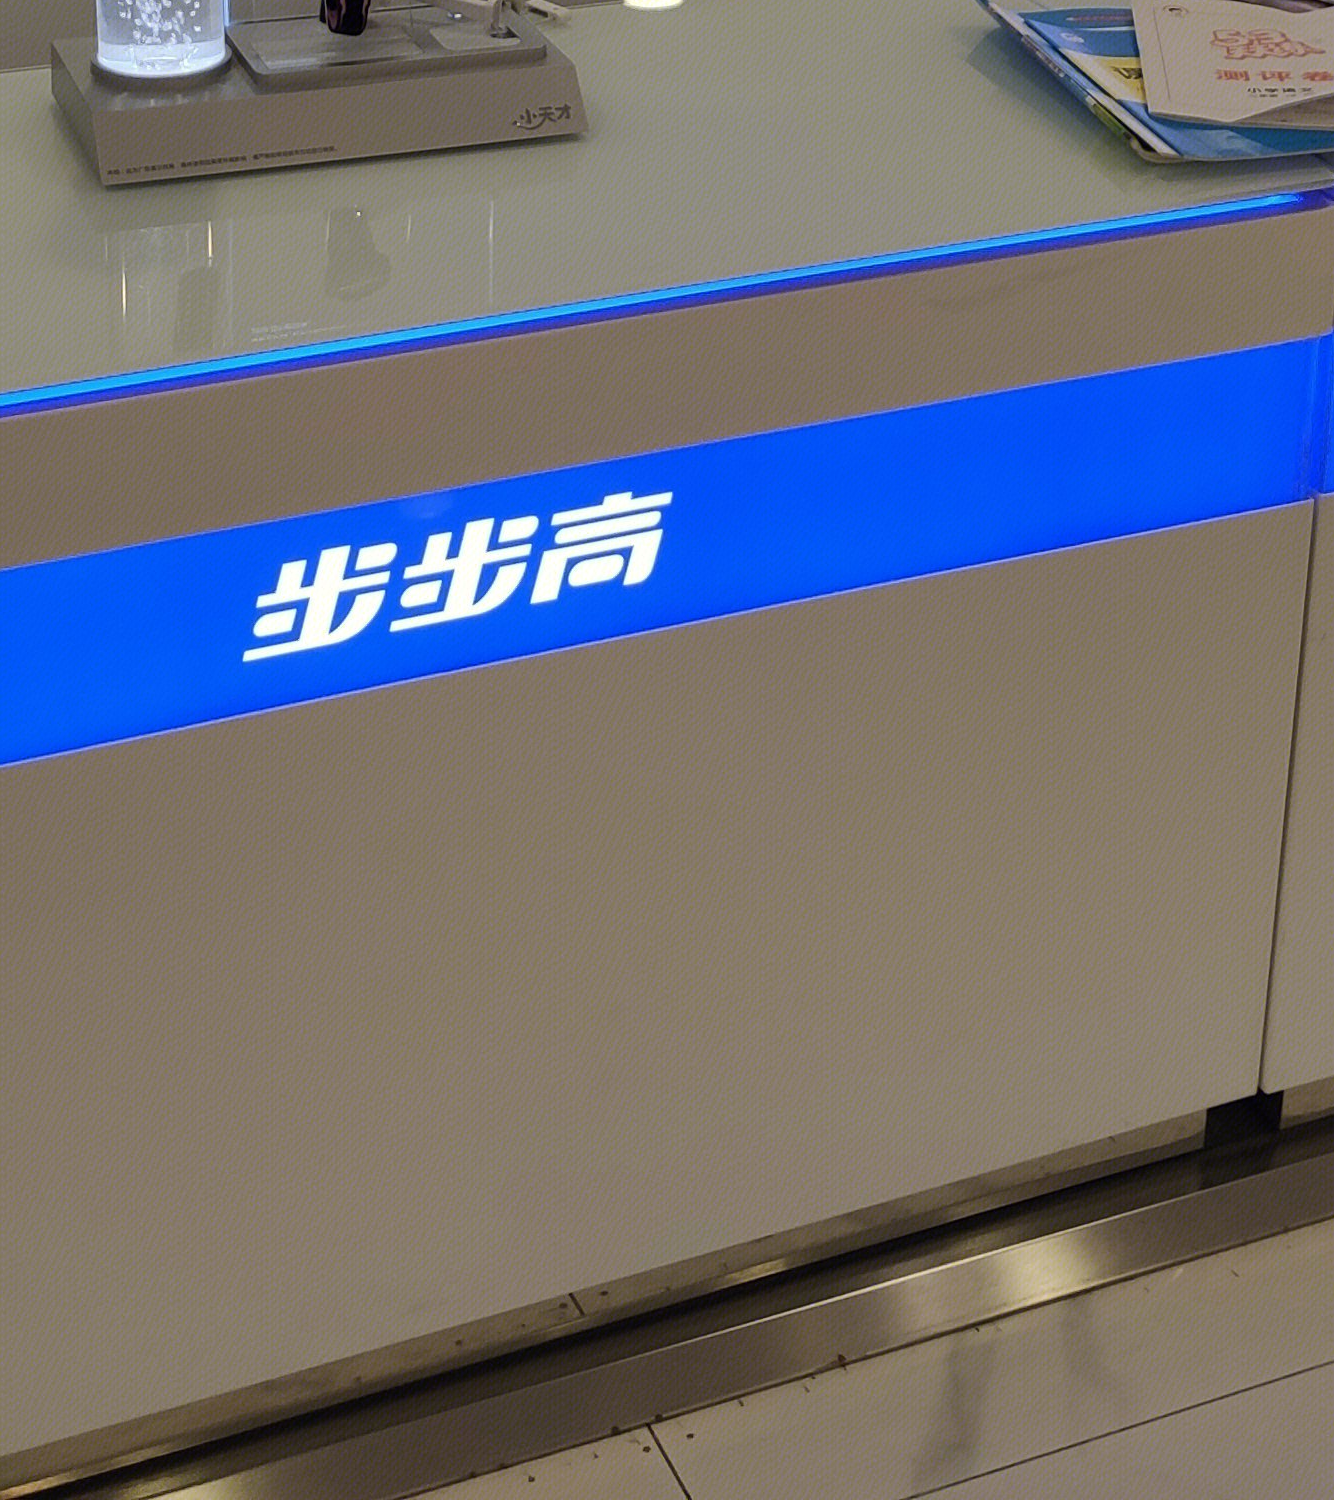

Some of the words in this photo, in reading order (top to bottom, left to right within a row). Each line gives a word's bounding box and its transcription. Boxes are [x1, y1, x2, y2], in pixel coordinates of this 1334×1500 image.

[512, 103, 572, 131] 小天才
[242, 491, 673, 663] 步步高
